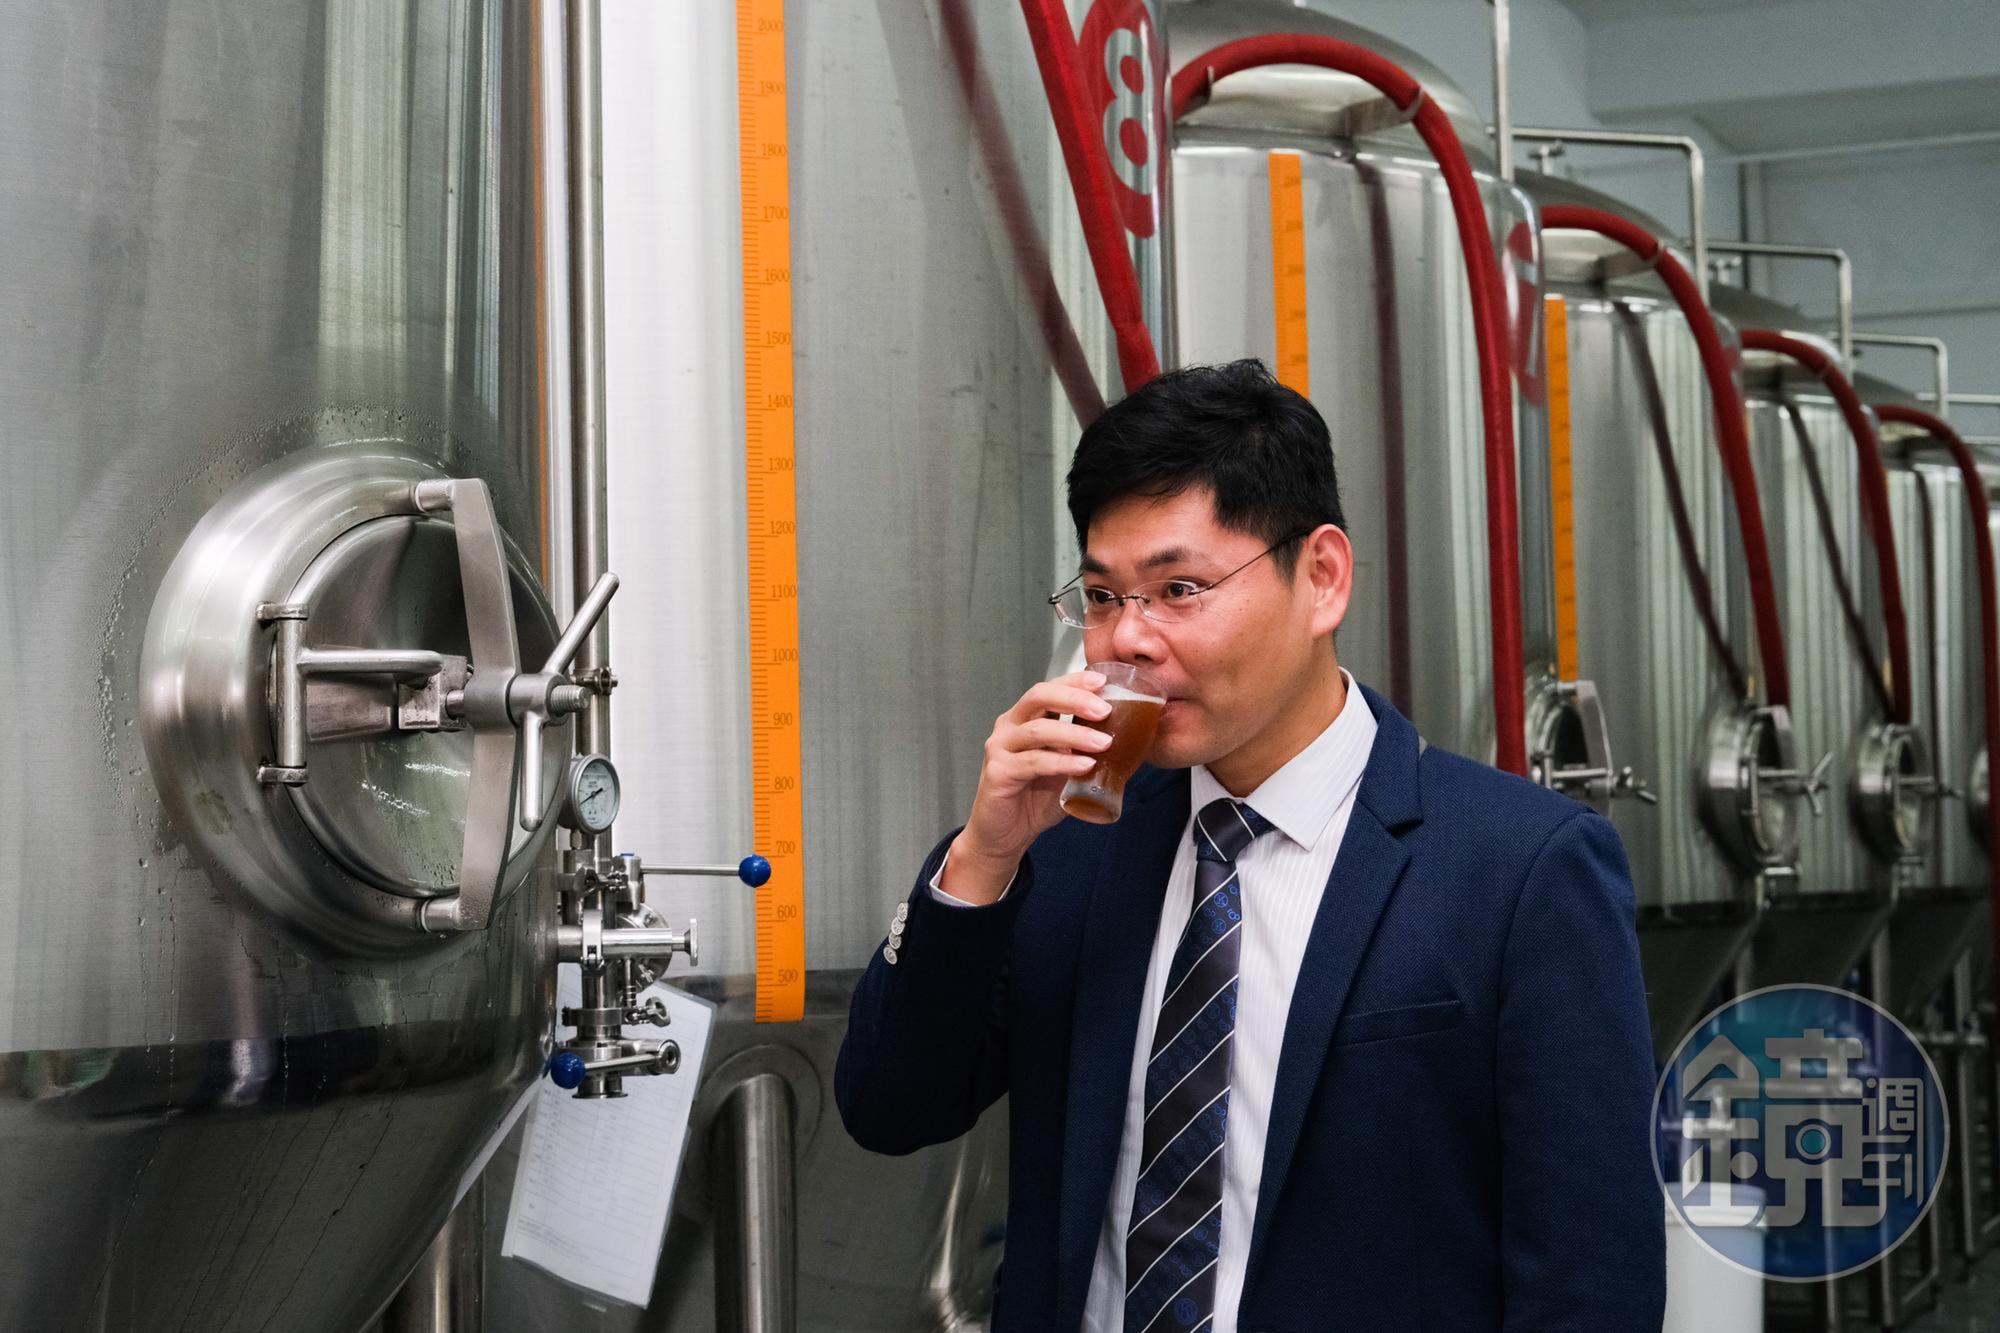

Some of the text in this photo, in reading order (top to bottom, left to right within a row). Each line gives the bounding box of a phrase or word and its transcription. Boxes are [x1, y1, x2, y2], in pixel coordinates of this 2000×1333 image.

[758, 17, 784, 32] 2000
[760, 80, 785, 95] 1900
[1103, 27, 1155, 196] 8
[762, 143, 787, 157] 1800
[763, 205, 789, 220] 1700
[765, 268, 790, 282] 1600
[766, 331, 792, 345] 1500
[768, 394, 793, 408] 1400
[769, 457, 793, 471] 1300
[770, 520, 795, 535] 1200
[771, 584, 797, 598] 1100
[773, 648, 798, 662] 1000
[773, 712, 793, 726] 900
[774, 776, 794, 790] 800
[776, 840, 796, 854] 700
[777, 904, 797, 918] 600
[777, 968, 798, 983] 500
